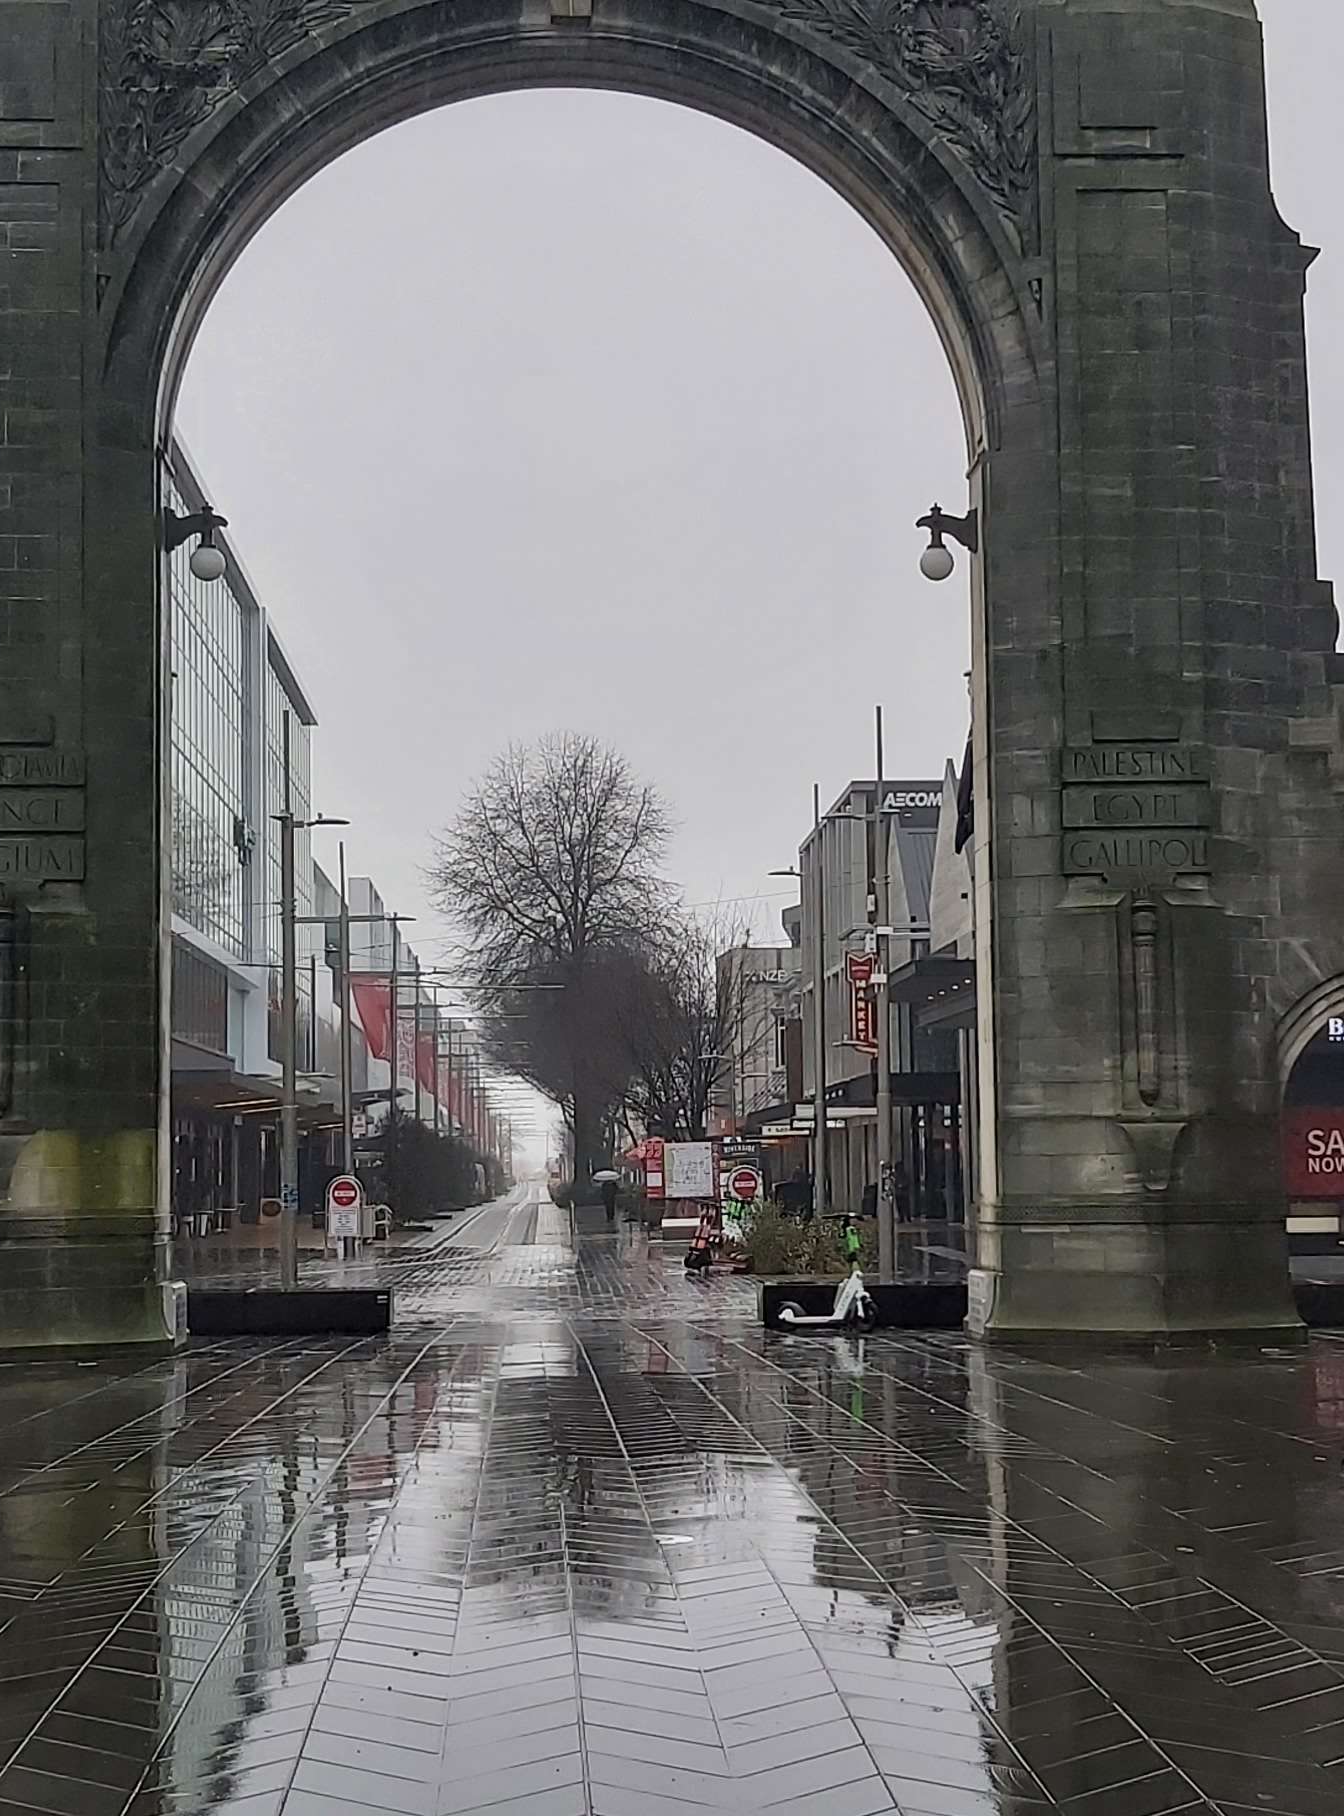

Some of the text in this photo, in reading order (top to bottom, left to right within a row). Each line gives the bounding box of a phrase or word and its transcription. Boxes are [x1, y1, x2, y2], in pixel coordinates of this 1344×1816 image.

[1072, 751, 1201, 776] PALESTINE
[883, 791, 943, 809] AECOM
[1092, 795, 1180, 821] EGYPT
